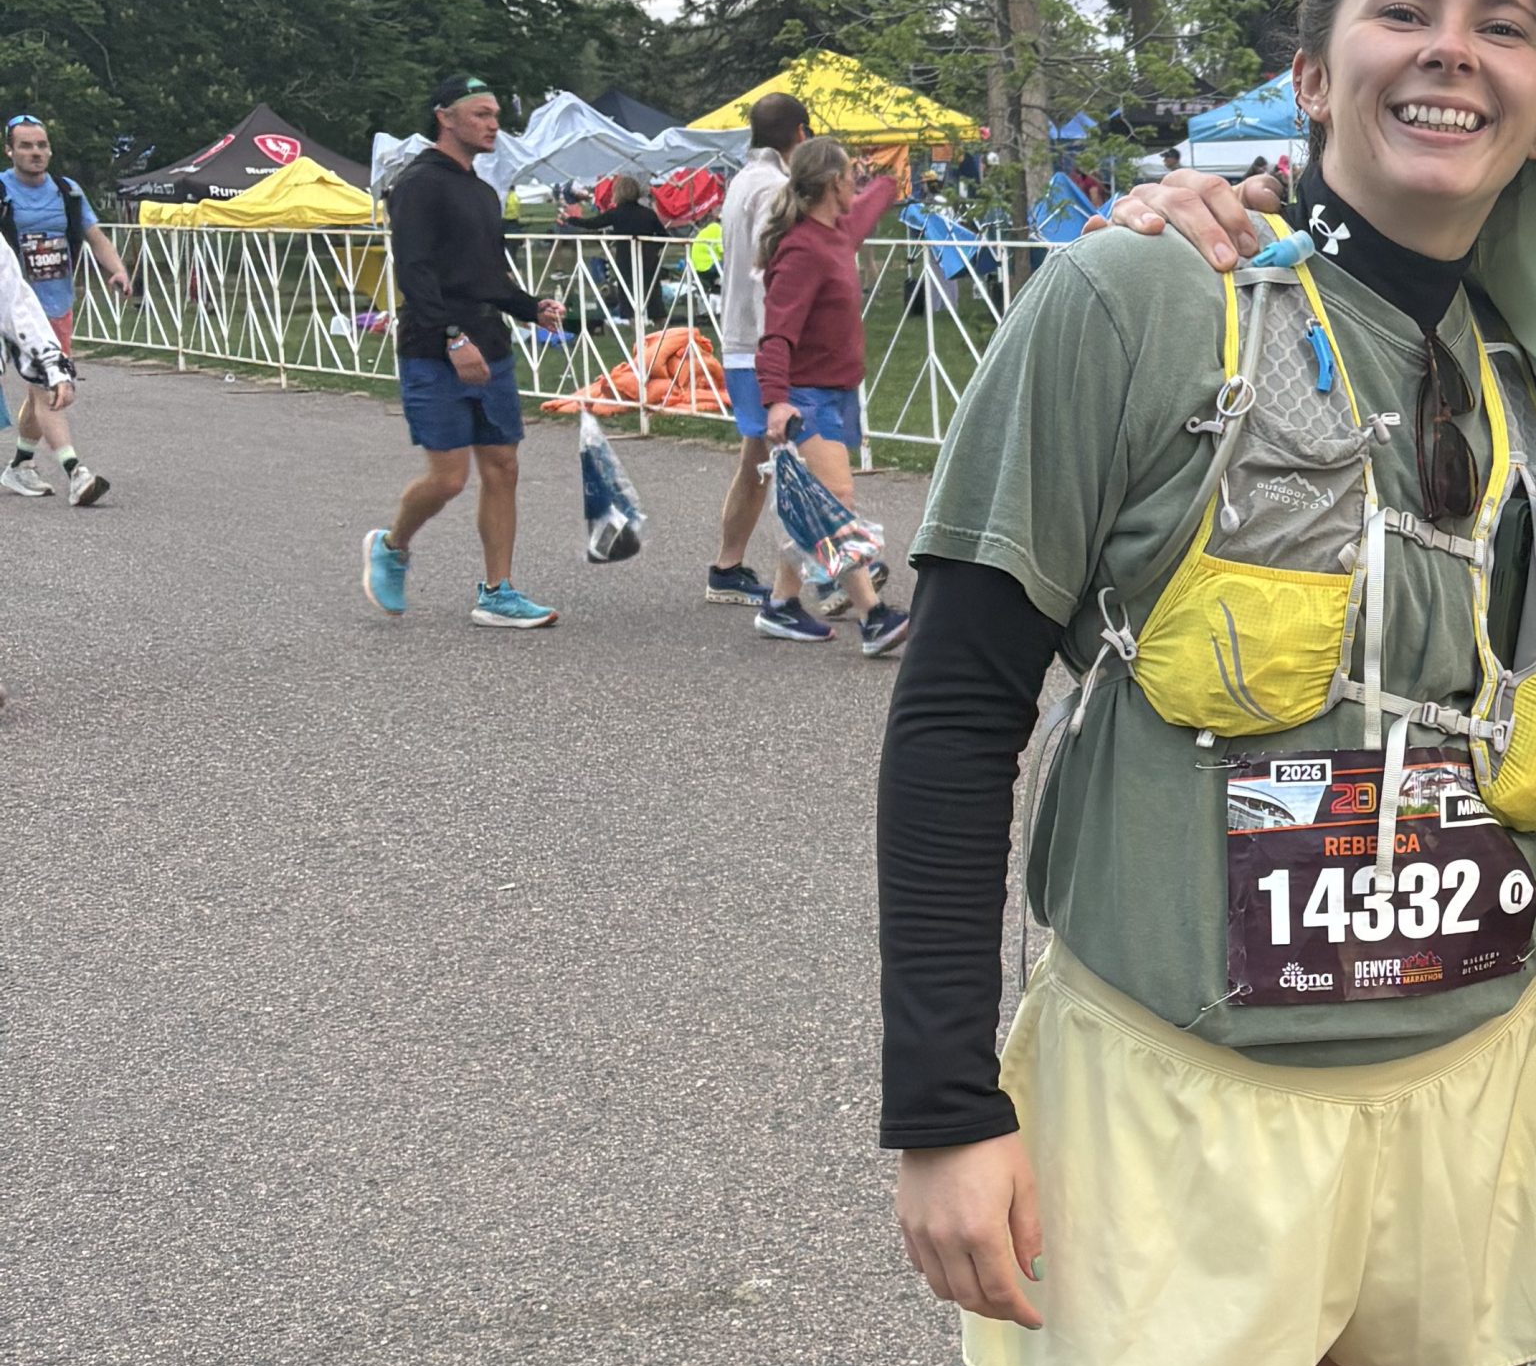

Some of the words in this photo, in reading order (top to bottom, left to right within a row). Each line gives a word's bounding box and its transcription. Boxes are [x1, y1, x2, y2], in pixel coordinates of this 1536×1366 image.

[1256, 482, 1306, 499] outdoor
[1264, 491, 1320, 510] INOXTO
[1280, 765, 1322, 781] 2026
[1331, 783, 1377, 813] 20
[1325, 834, 1421, 856] REBECA
[1258, 859, 1480, 946] 14332
[1355, 959, 1400, 980] DENVER
[1355, 978, 1400, 987] COLFAX
[1402, 971, 1444, 984] MARATHON
[1279, 972, 1334, 992] cigna
